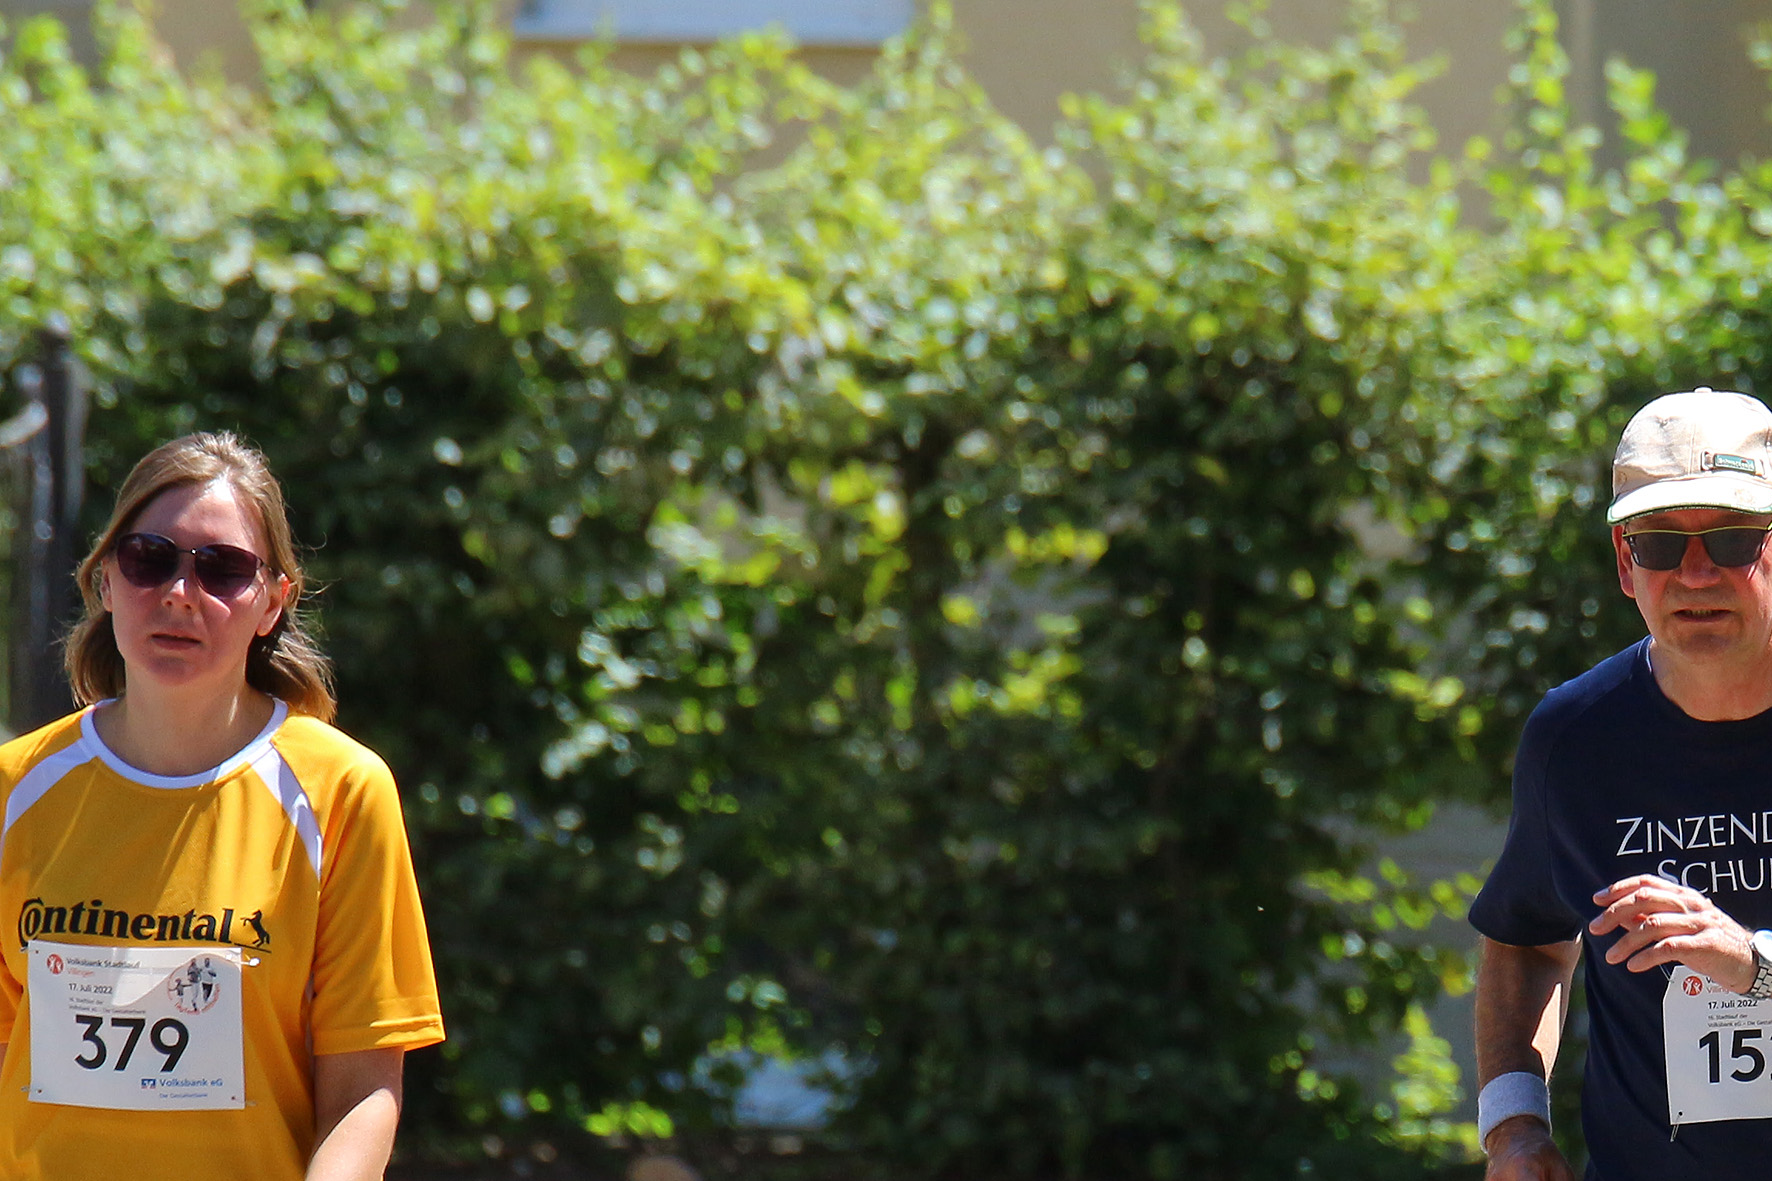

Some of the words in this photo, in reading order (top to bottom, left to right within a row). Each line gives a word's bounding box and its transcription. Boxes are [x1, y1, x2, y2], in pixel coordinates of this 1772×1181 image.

[18, 897, 235, 947] Continental
[1708, 1001, 1719, 1010] 17.
[1721, 1000, 1735, 1009] Juli
[1737, 999, 1758, 1008] 2022
[74, 1014, 189, 1072] 379
[159, 1078, 207, 1087] Volksbank
[210, 1078, 223, 1087] eG
